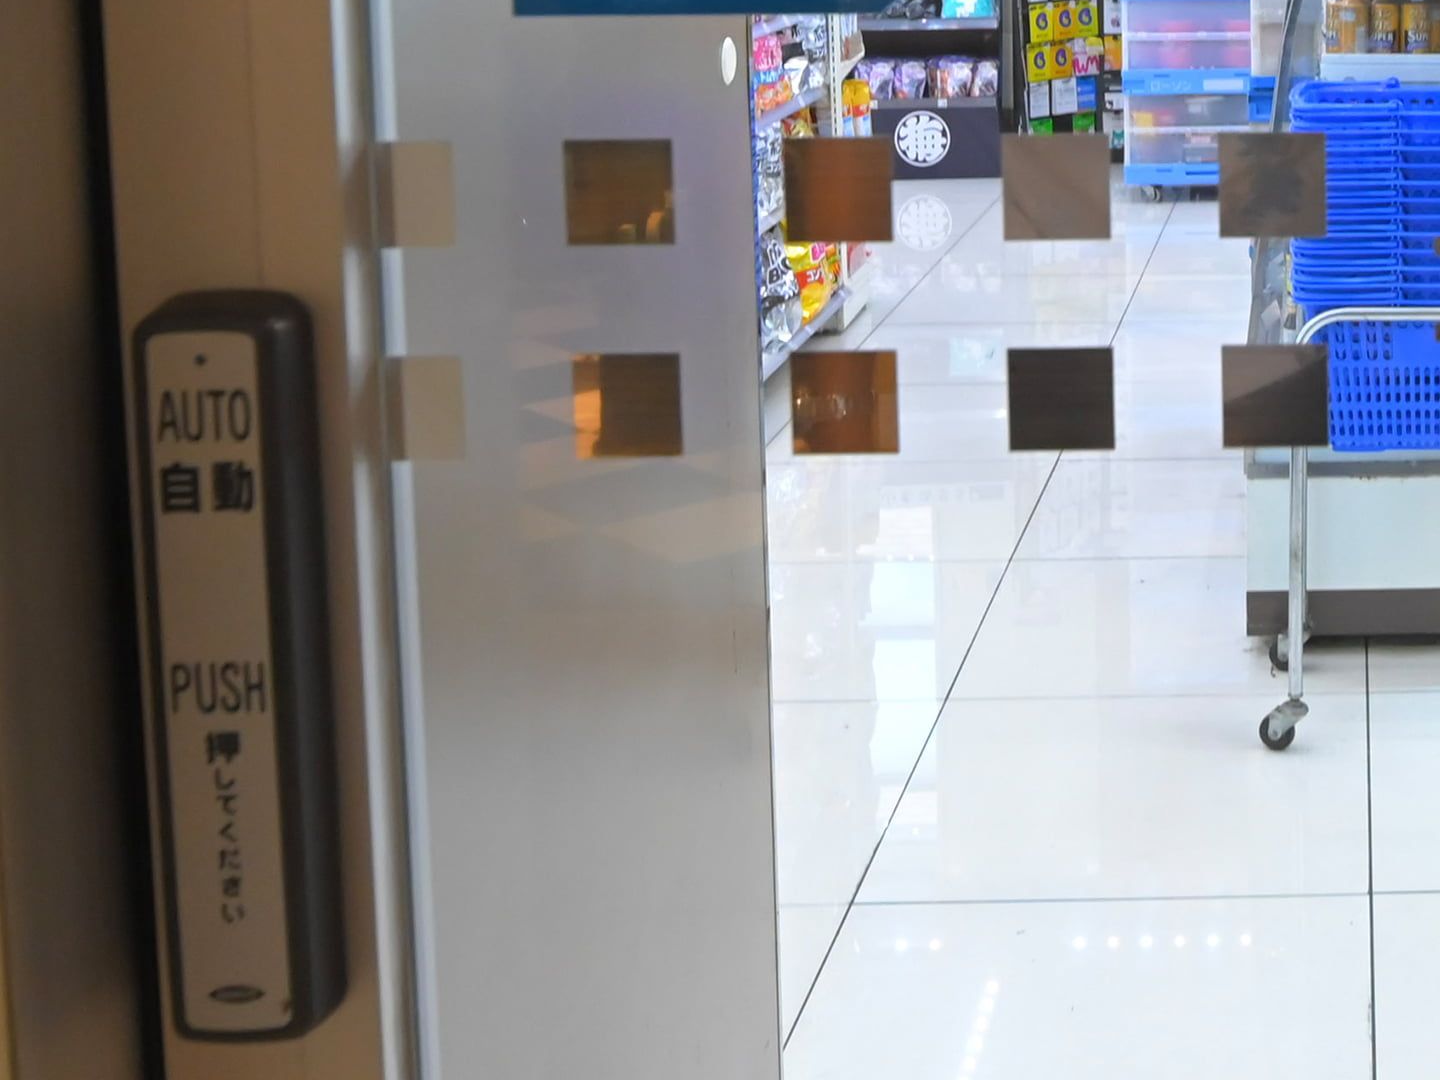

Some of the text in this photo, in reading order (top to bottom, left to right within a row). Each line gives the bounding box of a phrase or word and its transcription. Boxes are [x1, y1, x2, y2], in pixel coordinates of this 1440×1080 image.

[158, 390, 252, 442] AUTO
[160, 463, 255, 514] 自動
[171, 661, 267, 714] PUSH
[204, 731, 246, 923] 押してください
